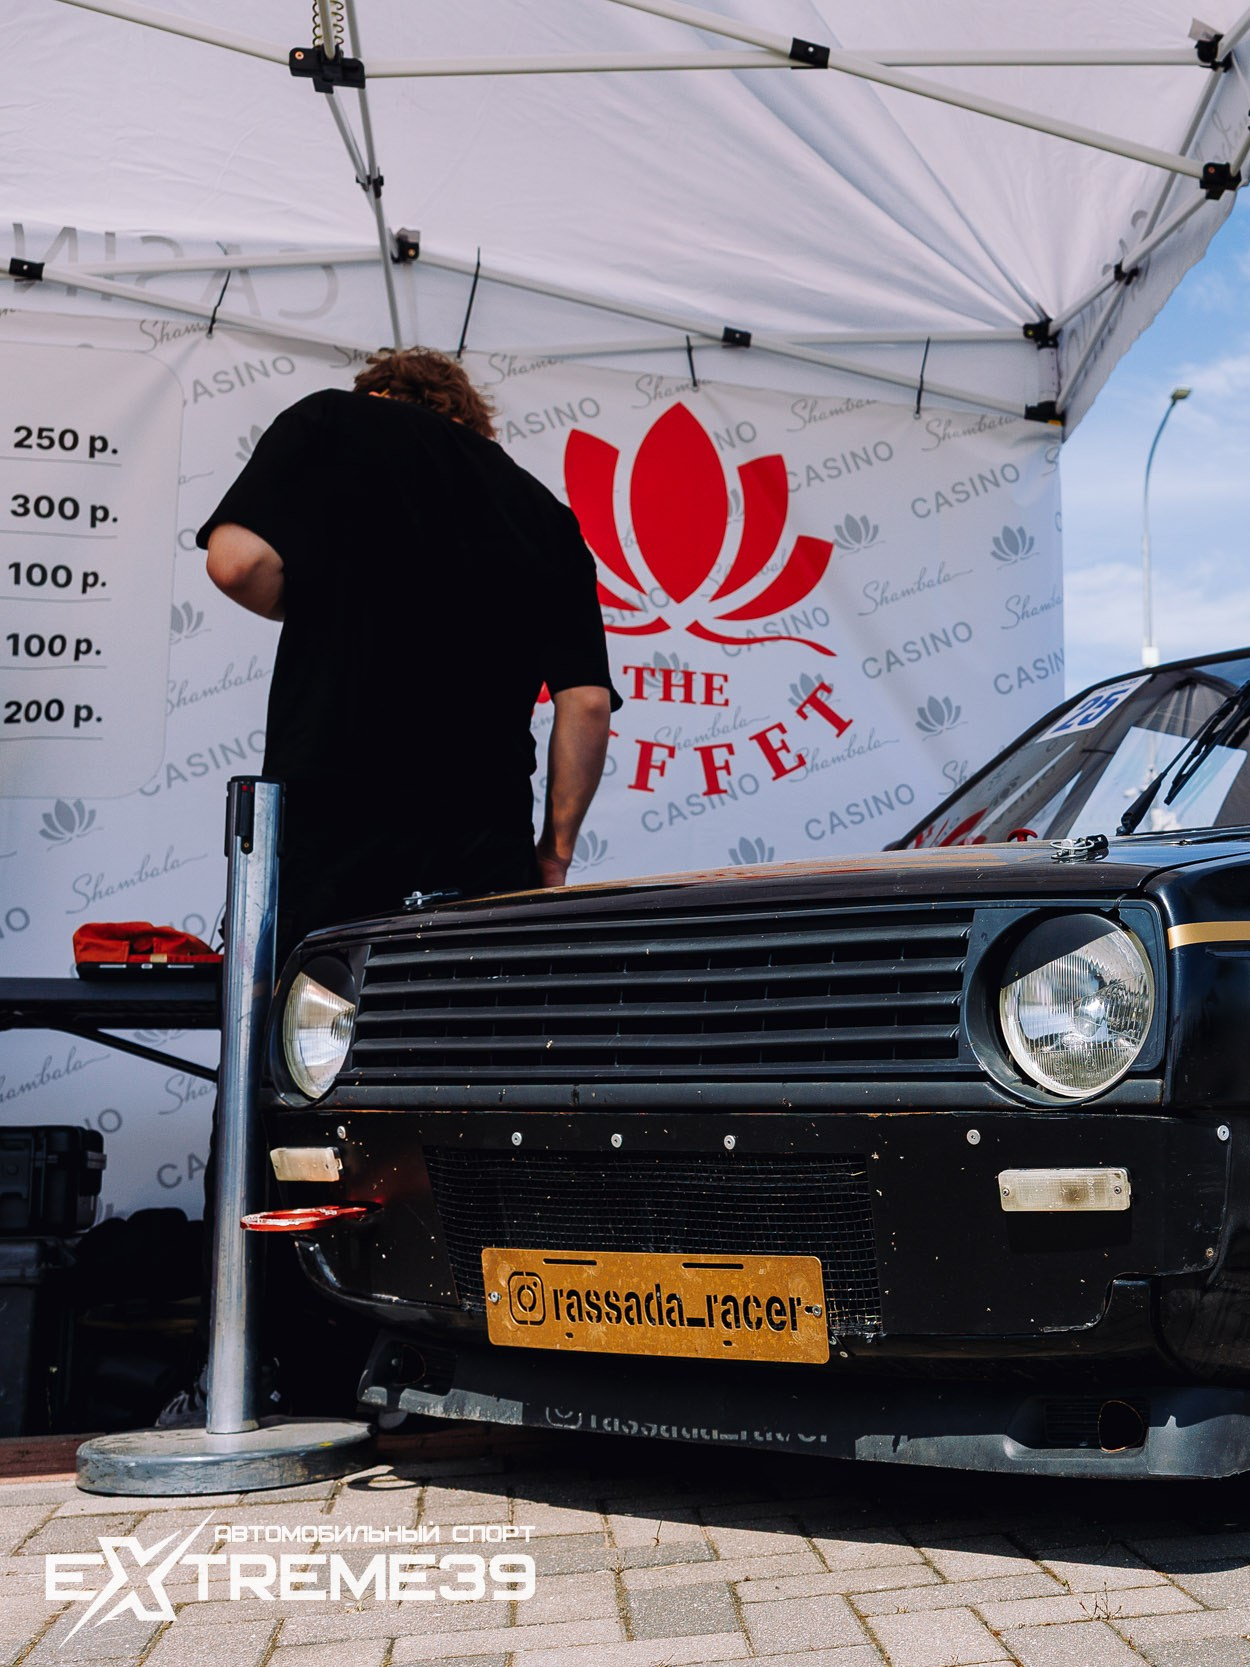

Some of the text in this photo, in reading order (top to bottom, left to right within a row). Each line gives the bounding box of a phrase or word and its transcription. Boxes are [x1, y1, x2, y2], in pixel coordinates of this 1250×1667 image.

[184, 355, 296, 407] ASINO
[13, 425, 79, 451] 250
[500, 397, 600, 444] ASINO
[10, 494, 80, 521] 300
[910, 462, 1020, 519] CASINO
[8, 562, 72, 589] 100
[857, 560, 974, 618] Shambala
[6, 632, 68, 658] 100
[720, 606, 830, 658] CASINO
[861, 621, 974, 679] CASINO
[623, 665, 730, 707] THE
[3, 698, 65, 725] 200
[1050, 688, 1131, 734] 25
[608, 682, 853, 796] FFET
[804, 783, 914, 841] CASINO
[65, 845, 208, 915] Shambala
[552, 1283, 802, 1332] rassada_racer
